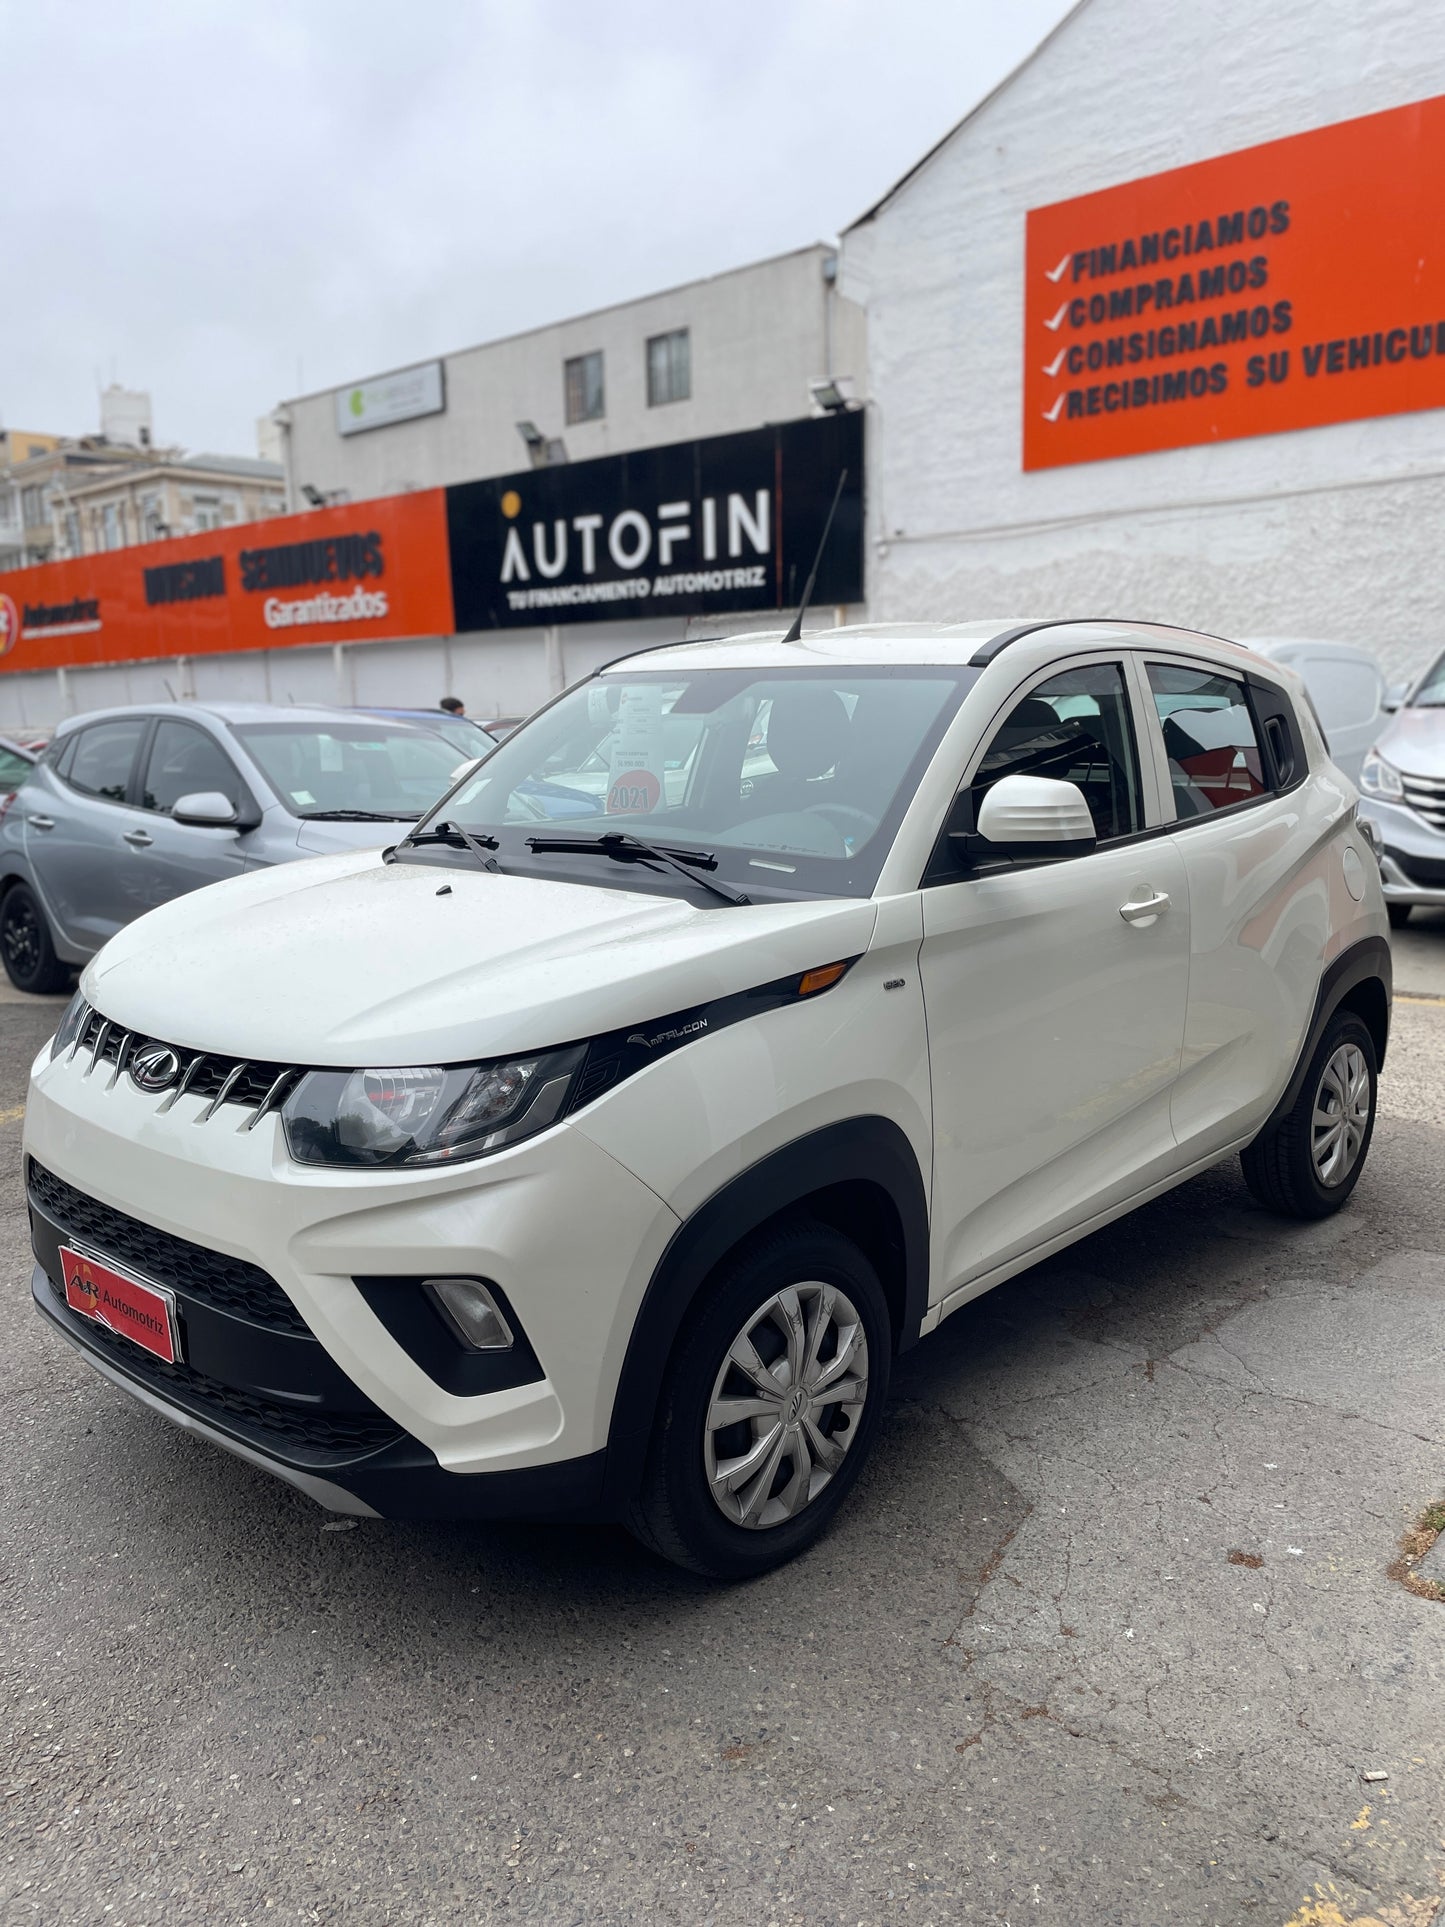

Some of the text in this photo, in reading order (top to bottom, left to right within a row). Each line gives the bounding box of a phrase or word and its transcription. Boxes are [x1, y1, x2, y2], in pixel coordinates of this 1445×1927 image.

[1071, 200, 1290, 282] FINANCIAMOS
[1068, 256, 1269, 328] COMPRAMOS
[1066, 300, 1293, 375] CONSIGNAMOS
[1066, 363, 1228, 419] RECIBIMOS
[1246, 350, 1290, 387] SU
[500, 488, 771, 583] AUTOFIN
[263, 585, 389, 629] Garantizados
[527, 578, 651, 609] FINANCIAMIENTO
[652, 566, 766, 597] AUTOMOTRIZ
[611, 785, 649, 810] 2021
[103, 1289, 165, 1336] Automotriz
